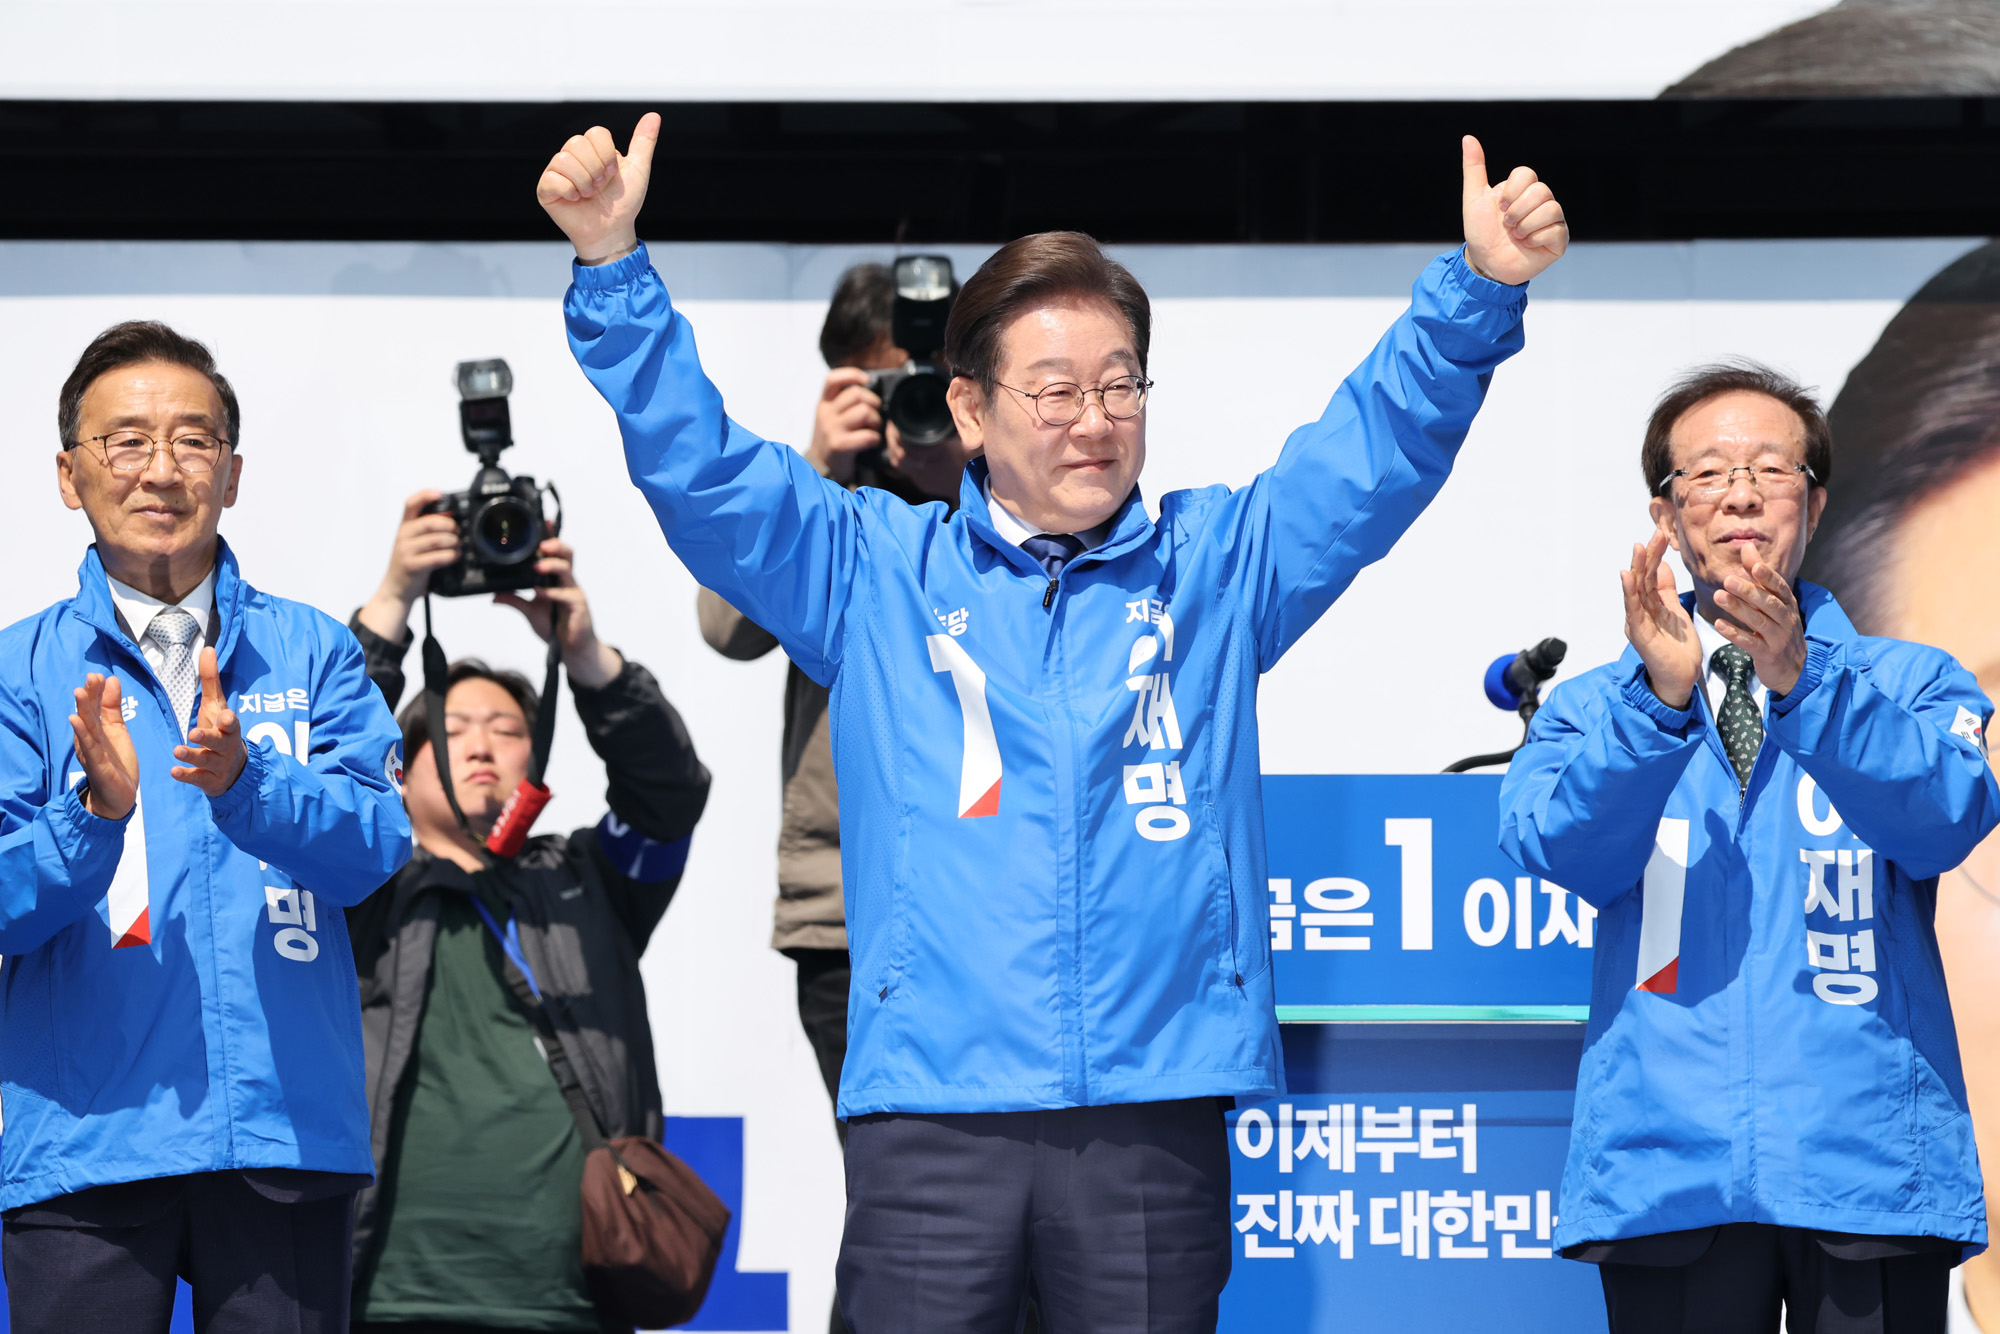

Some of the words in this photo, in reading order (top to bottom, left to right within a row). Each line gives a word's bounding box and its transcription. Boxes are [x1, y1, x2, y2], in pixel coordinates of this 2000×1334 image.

[1125, 598, 1170, 626] 지금
[238, 687, 310, 714] 지금은
[925, 633, 1003, 819] 1
[1122, 612, 1191, 842] 이재명
[1384, 817, 1433, 951] 1
[1235, 1103, 1478, 1174] 이제부터
[1234, 1189, 1360, 1260] 진짜
[1369, 1189, 1558, 1261] 대한민
